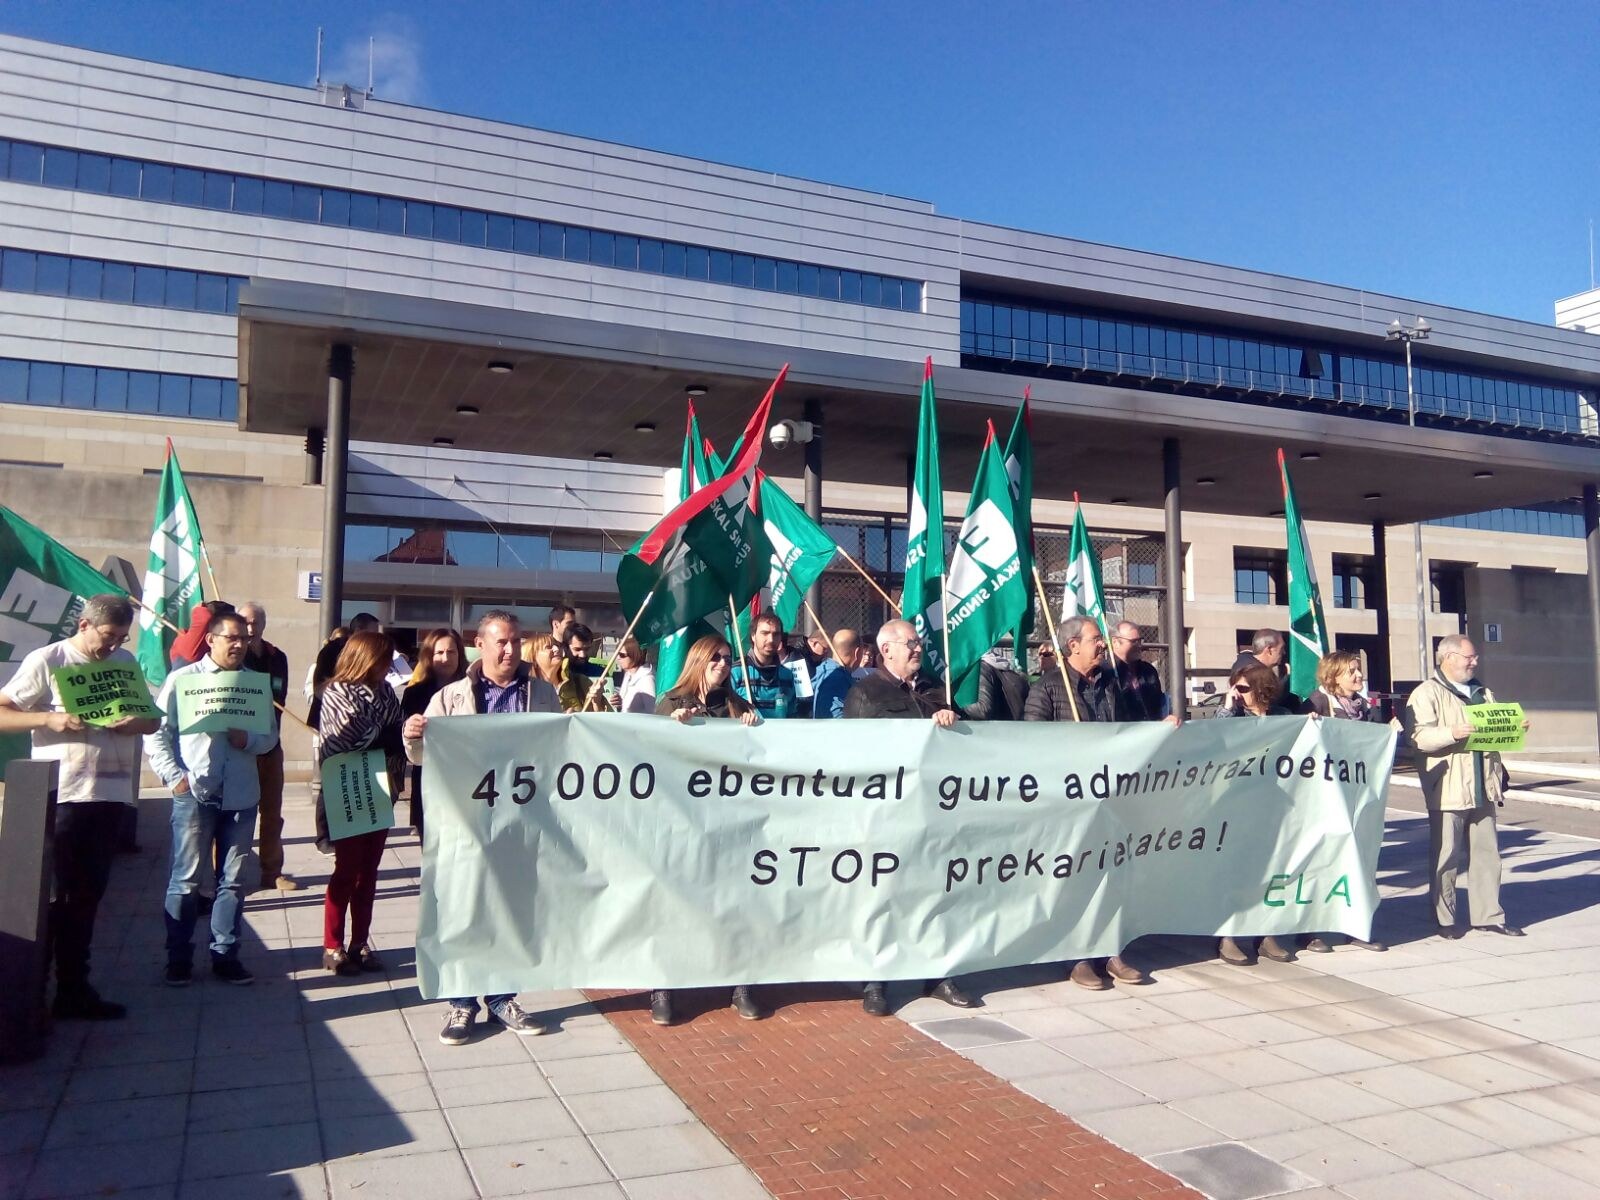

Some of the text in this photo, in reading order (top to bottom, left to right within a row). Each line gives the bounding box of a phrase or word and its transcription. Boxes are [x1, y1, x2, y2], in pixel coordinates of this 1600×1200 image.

[67, 669, 136, 687] 10 URTEZ
[88, 681, 128, 693] BEHIN
[184, 686, 264, 697] EGONKORTASUNA
[204, 697, 247, 706] ZERBITZU
[78, 708, 114, 721] NOIZ
[195, 708, 256, 717] PUBLIKOETAN
[1472, 709, 1518, 719] 10 URTEZ
[687, 764, 905, 800] ebentual
[939, 773, 1039, 810] gure
[1064, 748, 1367, 800] administrazioetan
[340, 763, 353, 823] PUBLIKOETAN
[351, 770, 363, 811] ZERBITZU
[750, 846, 900, 886] STOP
[1263, 873, 1352, 907] ELA
